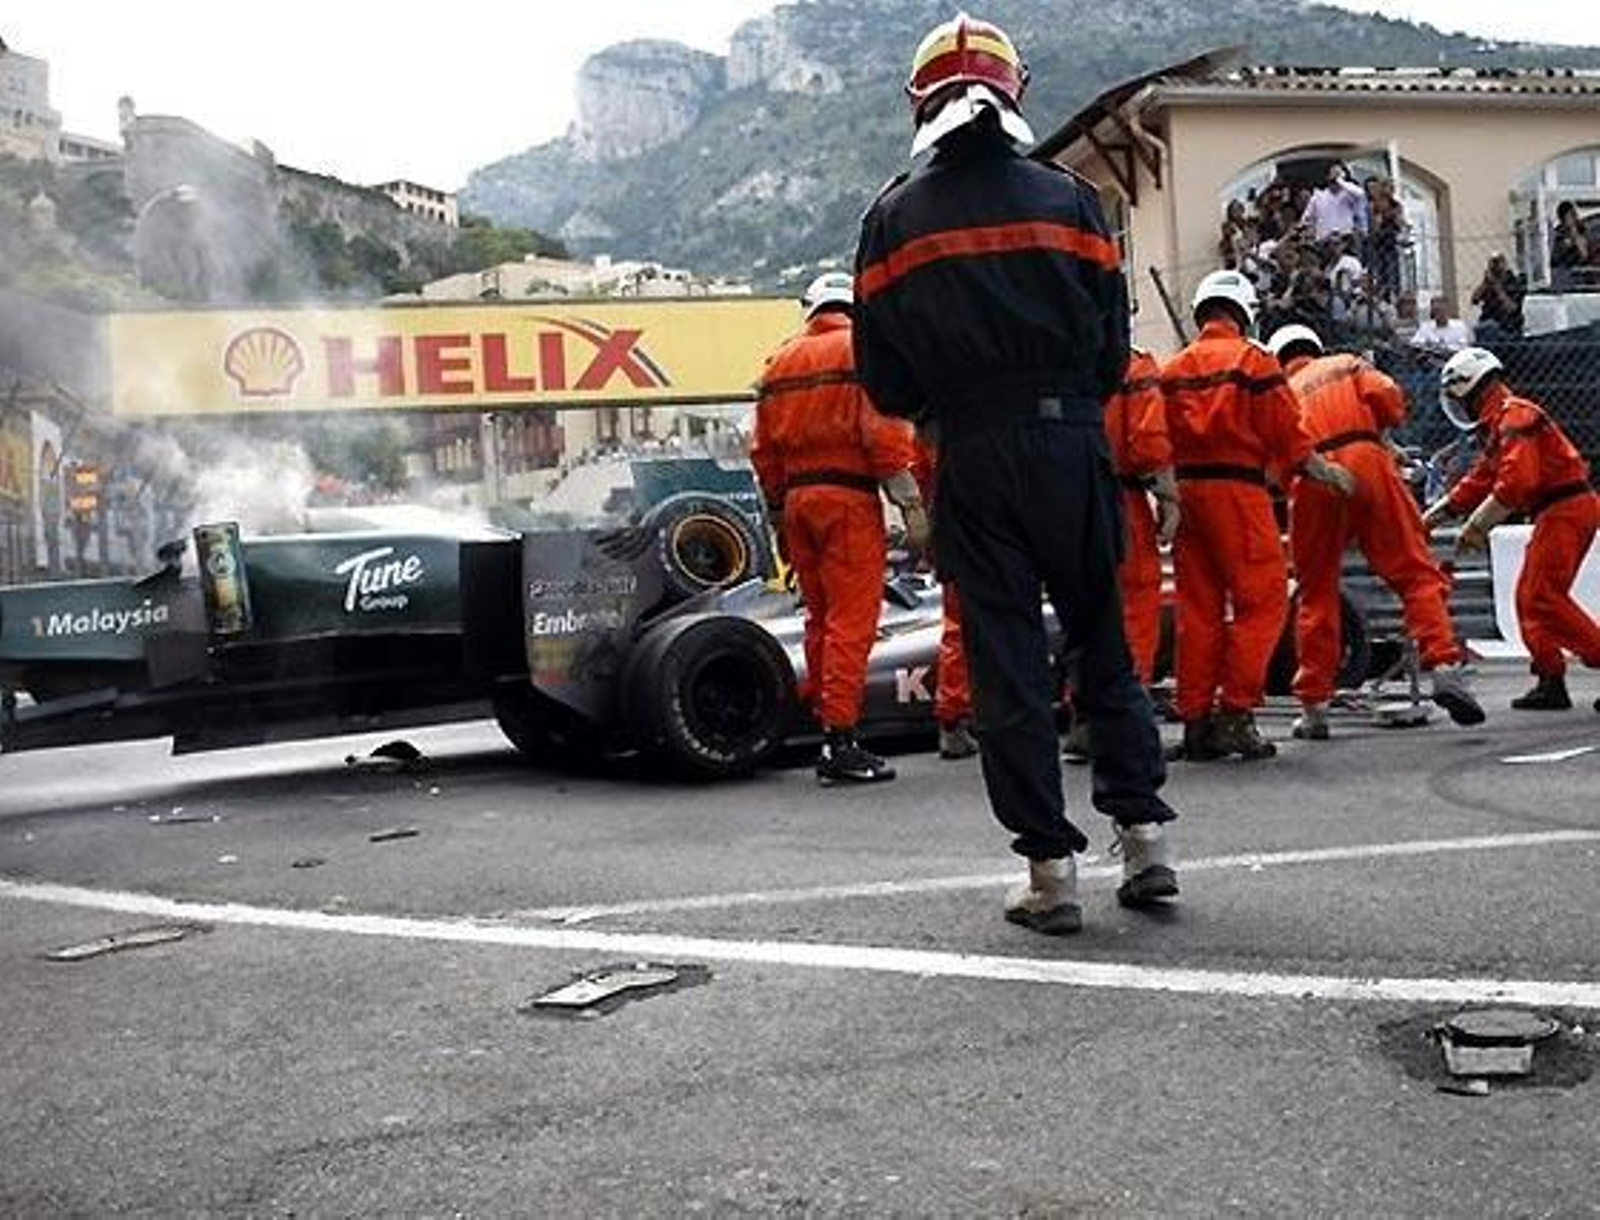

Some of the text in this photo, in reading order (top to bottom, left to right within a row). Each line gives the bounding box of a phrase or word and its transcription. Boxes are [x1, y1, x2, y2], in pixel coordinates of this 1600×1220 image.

[321, 316, 664, 398] HELIX
[335, 547, 423, 611] Tune
[31, 599, 169, 638] 1Malaysia
[360, 594, 409, 613] Group
[532, 601, 627, 635] Embrel
